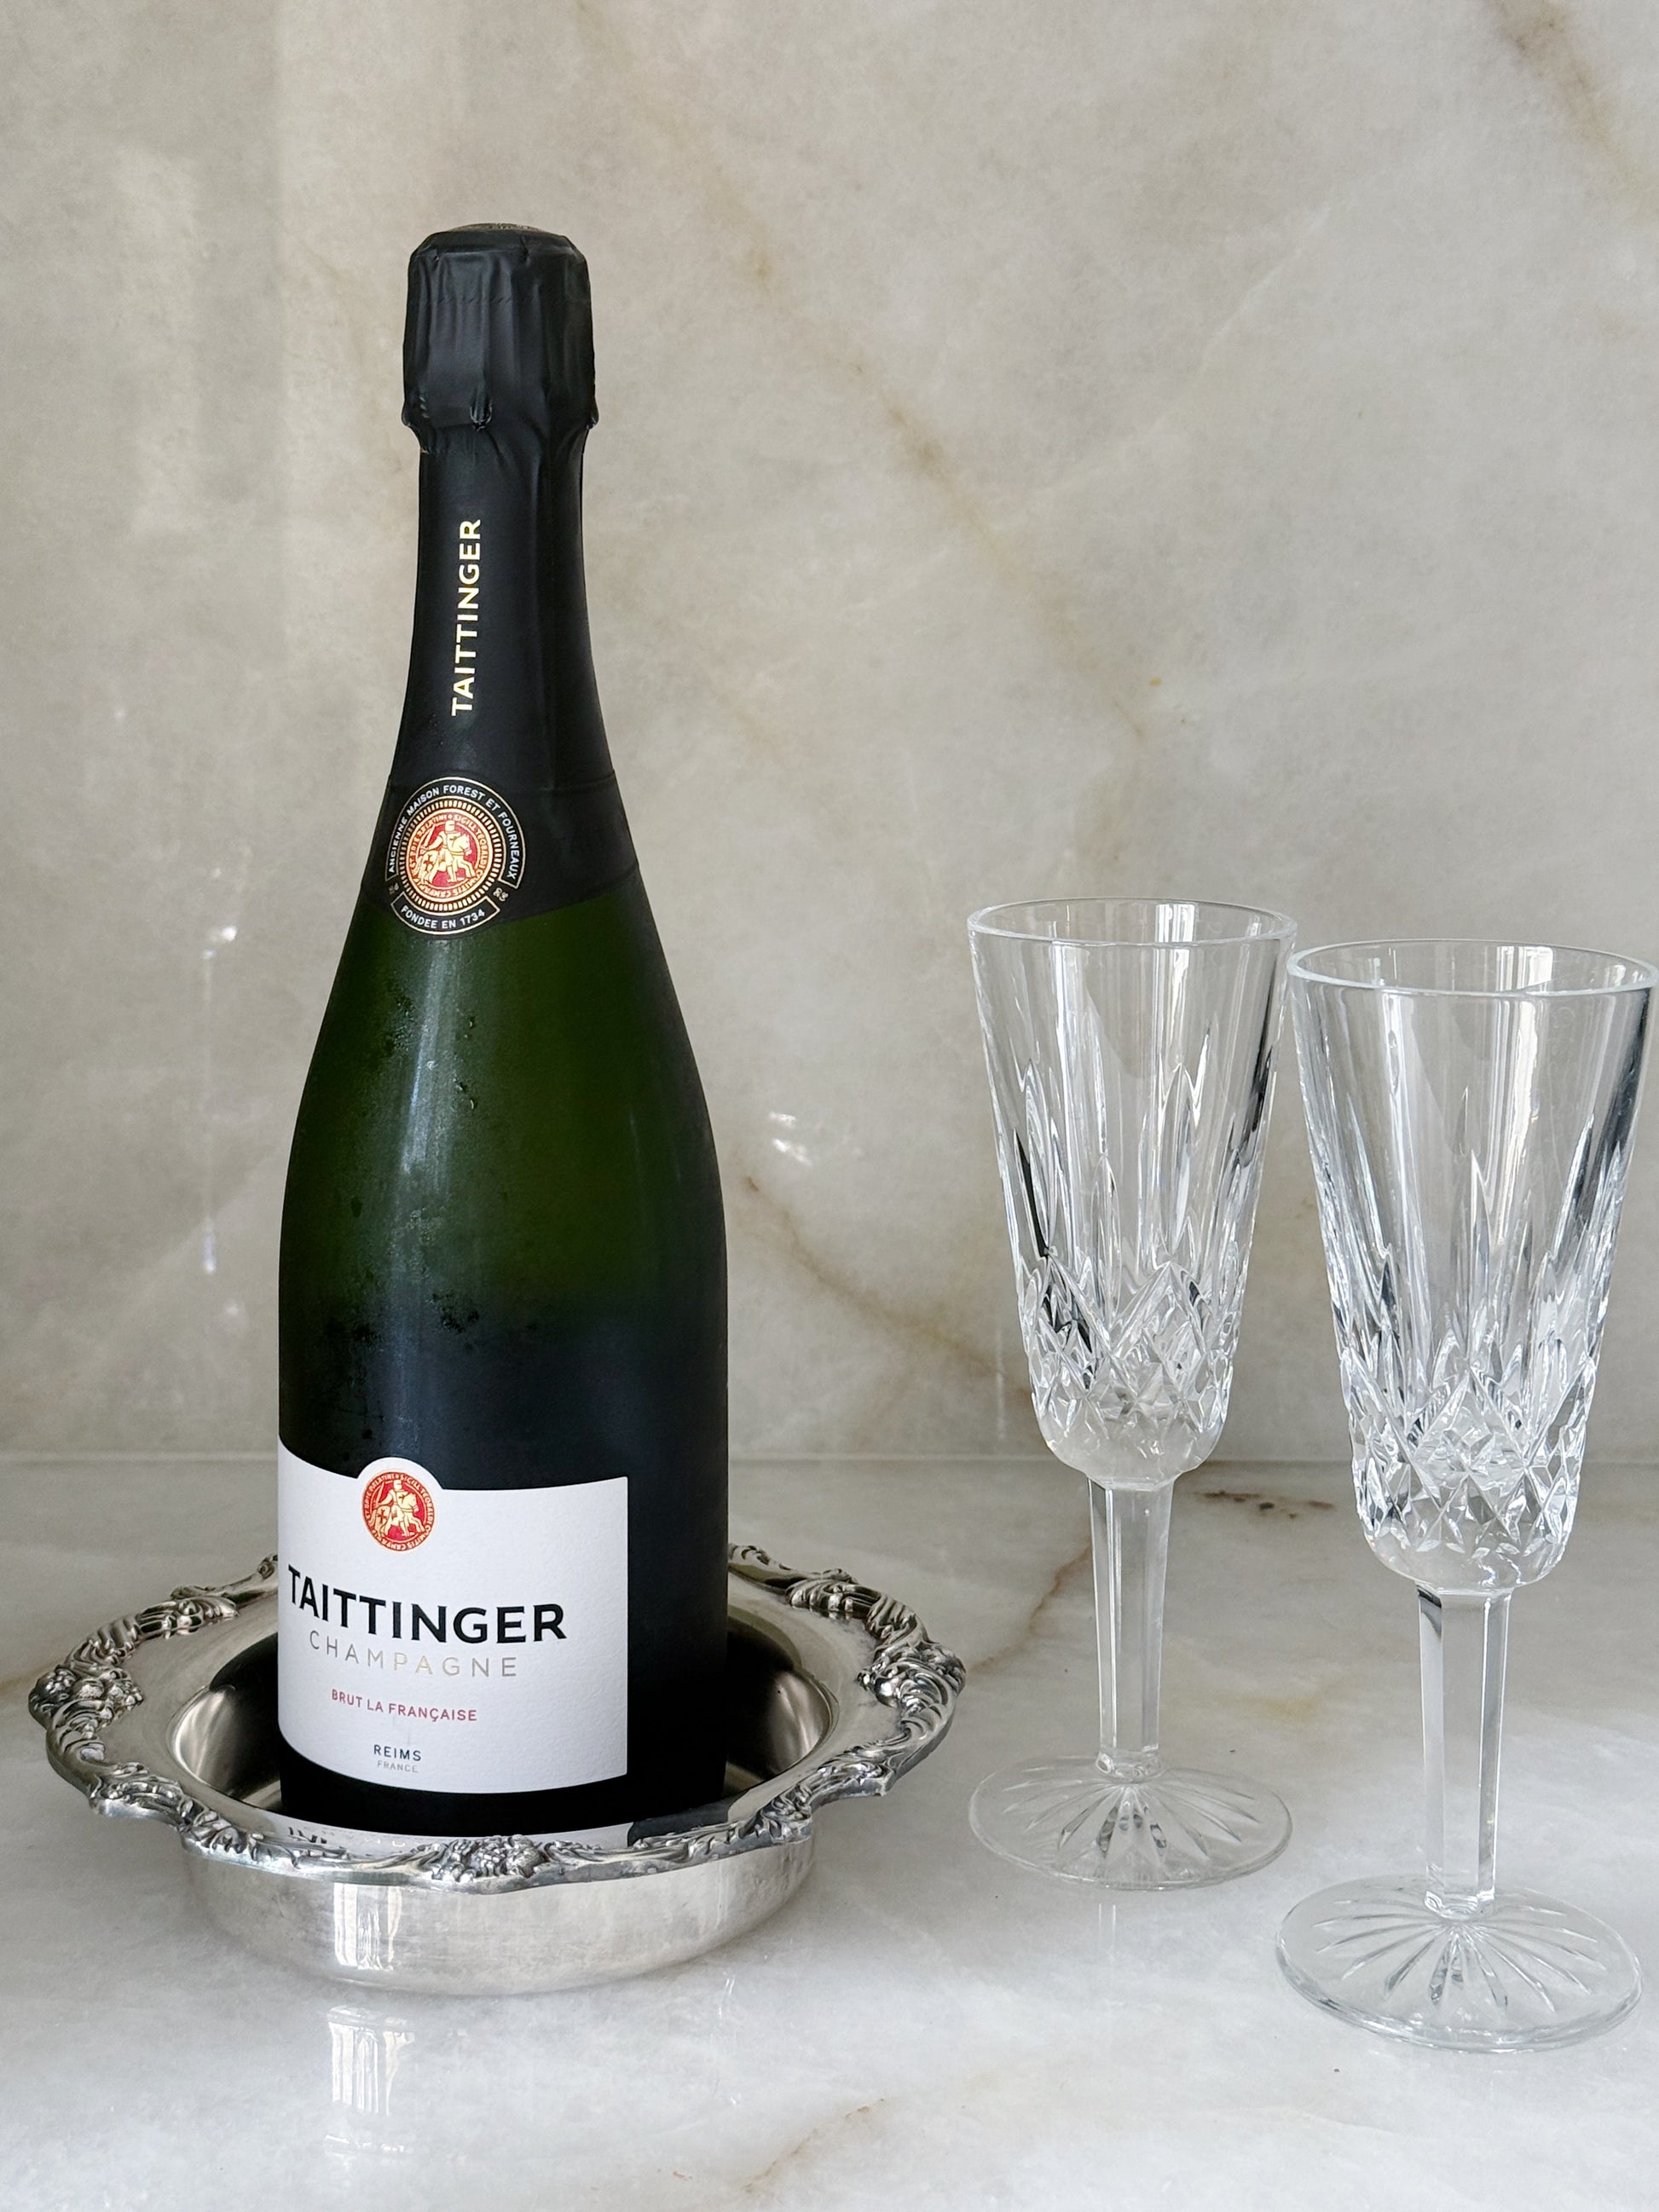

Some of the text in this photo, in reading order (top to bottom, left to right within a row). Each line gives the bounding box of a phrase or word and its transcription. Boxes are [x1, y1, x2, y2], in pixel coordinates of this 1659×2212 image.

[451, 519, 482, 717] TAITTINGER
[389, 784, 520, 880] ANCIENNE MAISON FOREST ET FOURNEAUX
[401, 904, 486, 929] FONDEE EN 1734
[287, 1564, 567, 1643] TAITTINGER
[309, 1629, 517, 1678] CHAMPAGNE
[331, 1688, 477, 1723] BRUT LA FRANÇAISE
[373, 1744, 422, 1762] REIMS
[377, 1760, 419, 1774] FRANCE
